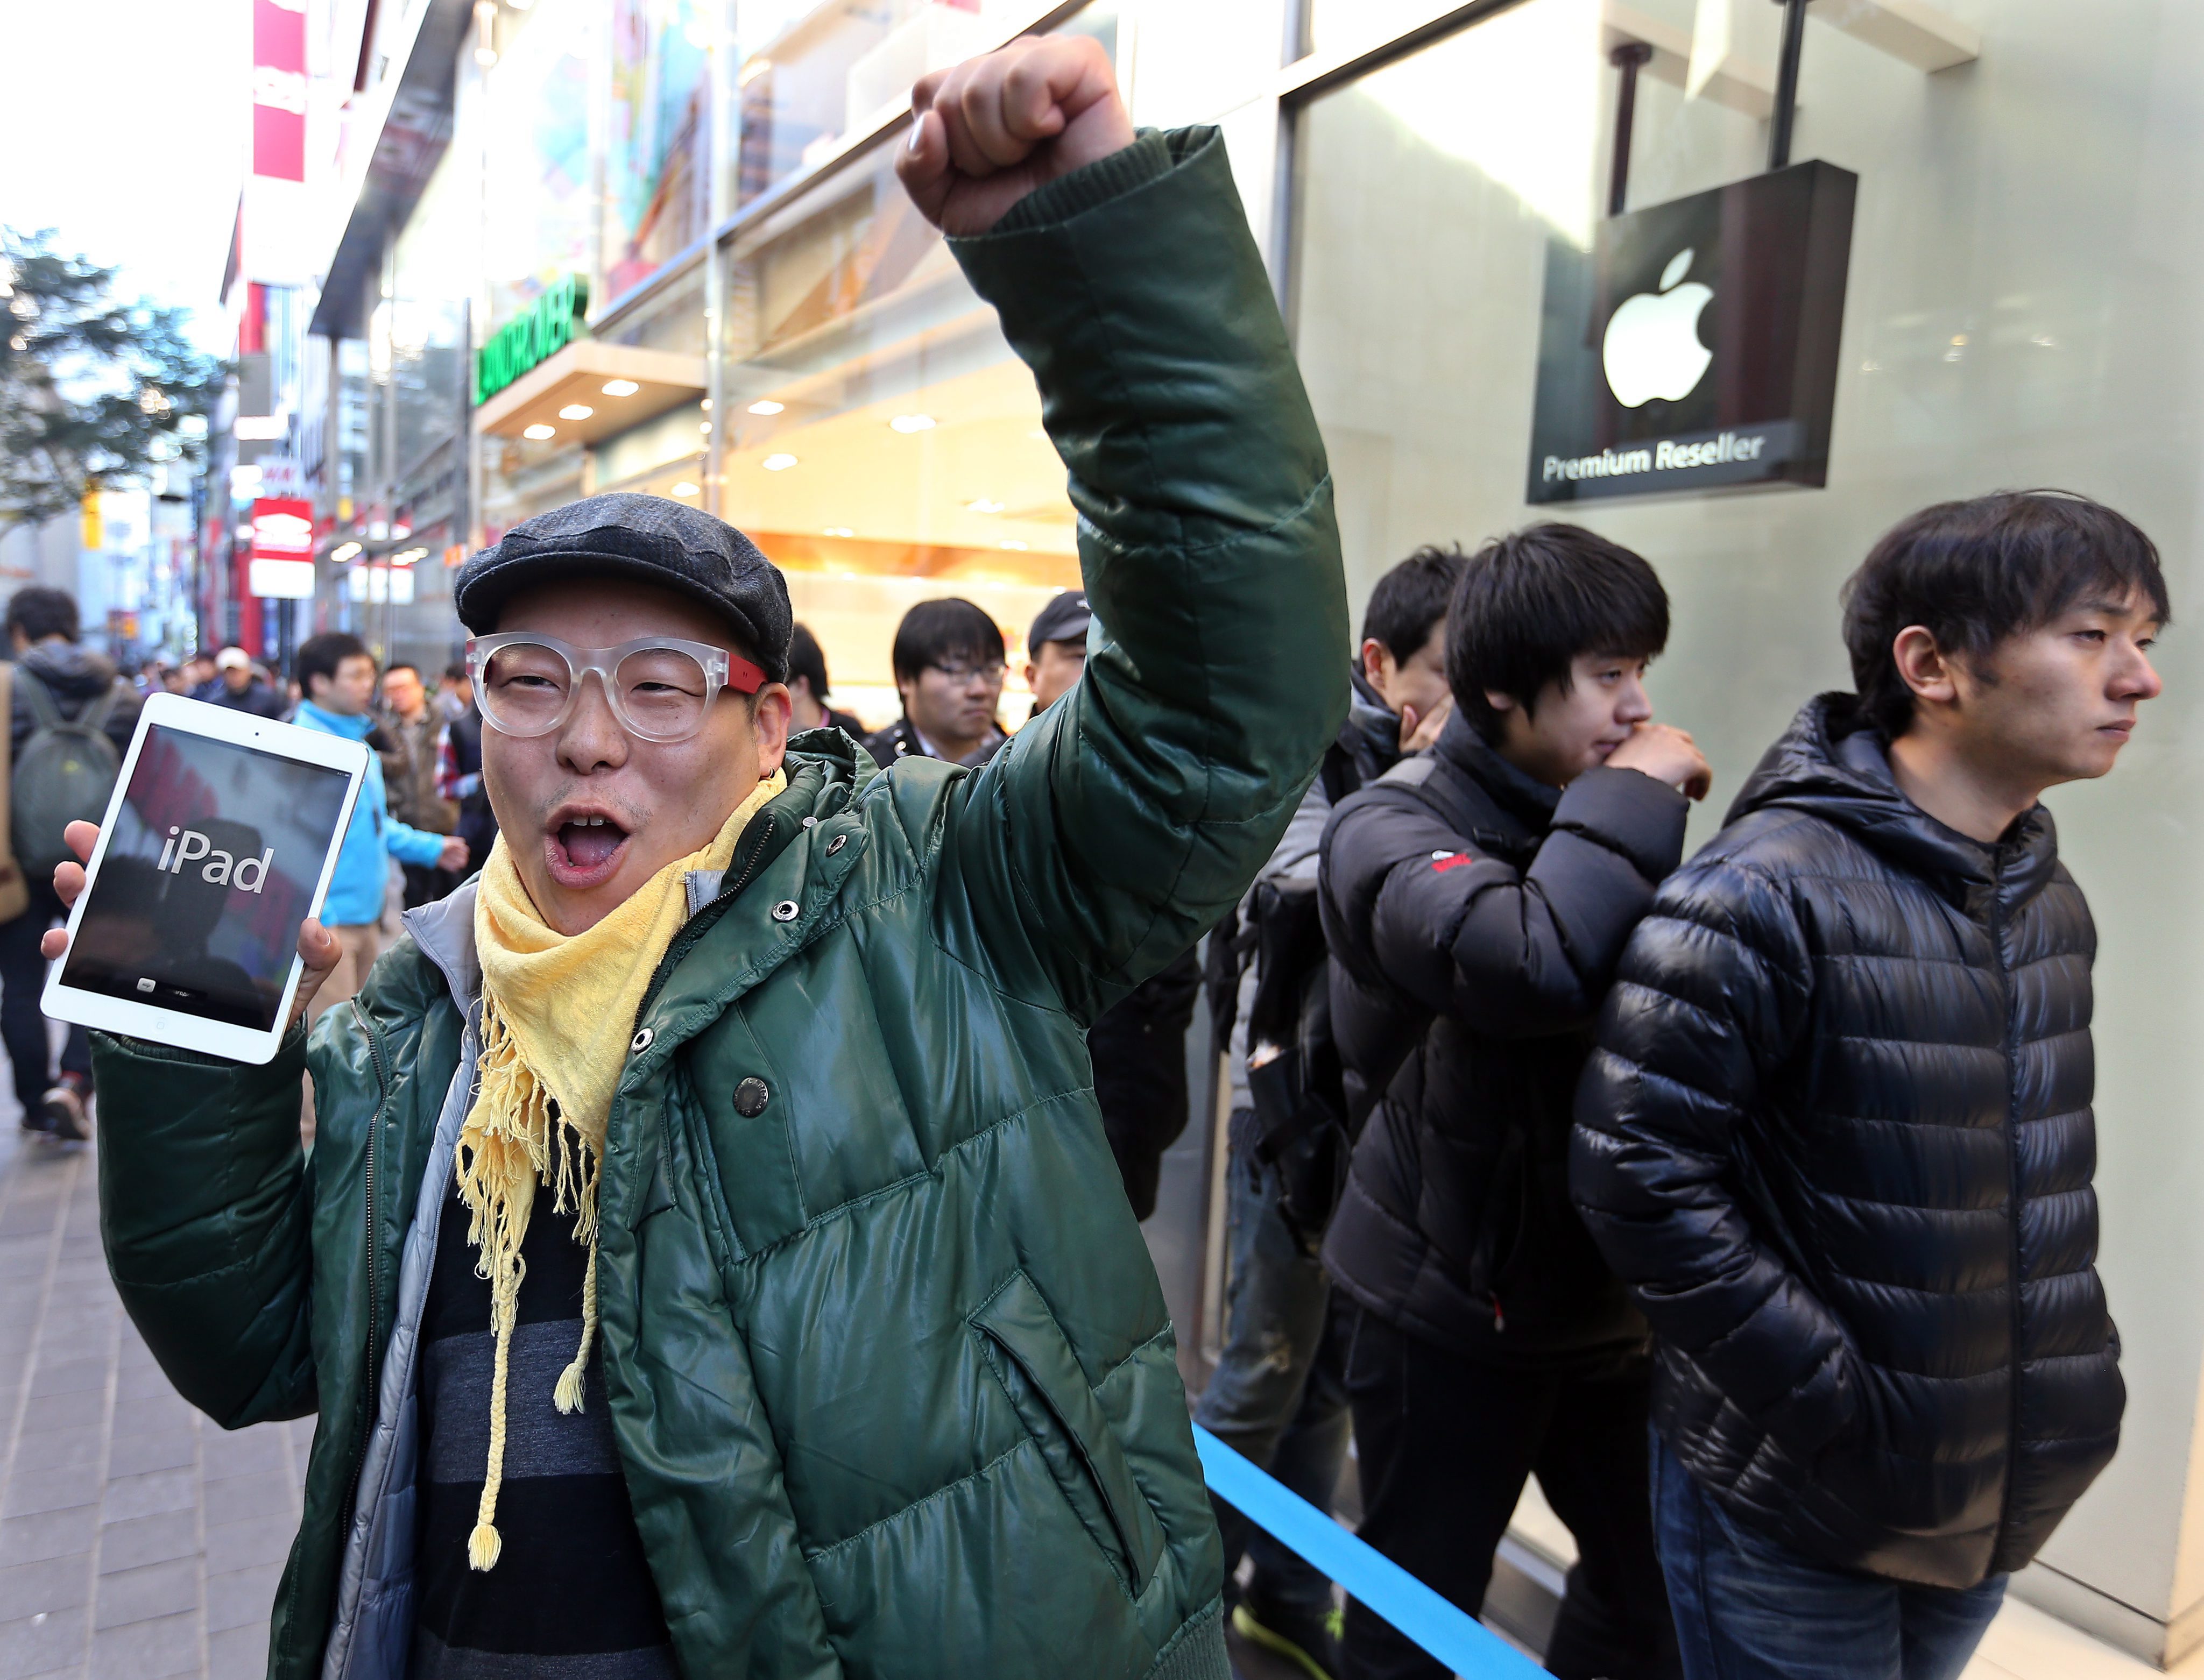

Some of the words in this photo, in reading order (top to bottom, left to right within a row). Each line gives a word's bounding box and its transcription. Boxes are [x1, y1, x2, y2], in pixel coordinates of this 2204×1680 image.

[1543, 449, 1651, 482] Premium
[1655, 432, 1766, 471] Reseller
[157, 825, 274, 894] iPad
